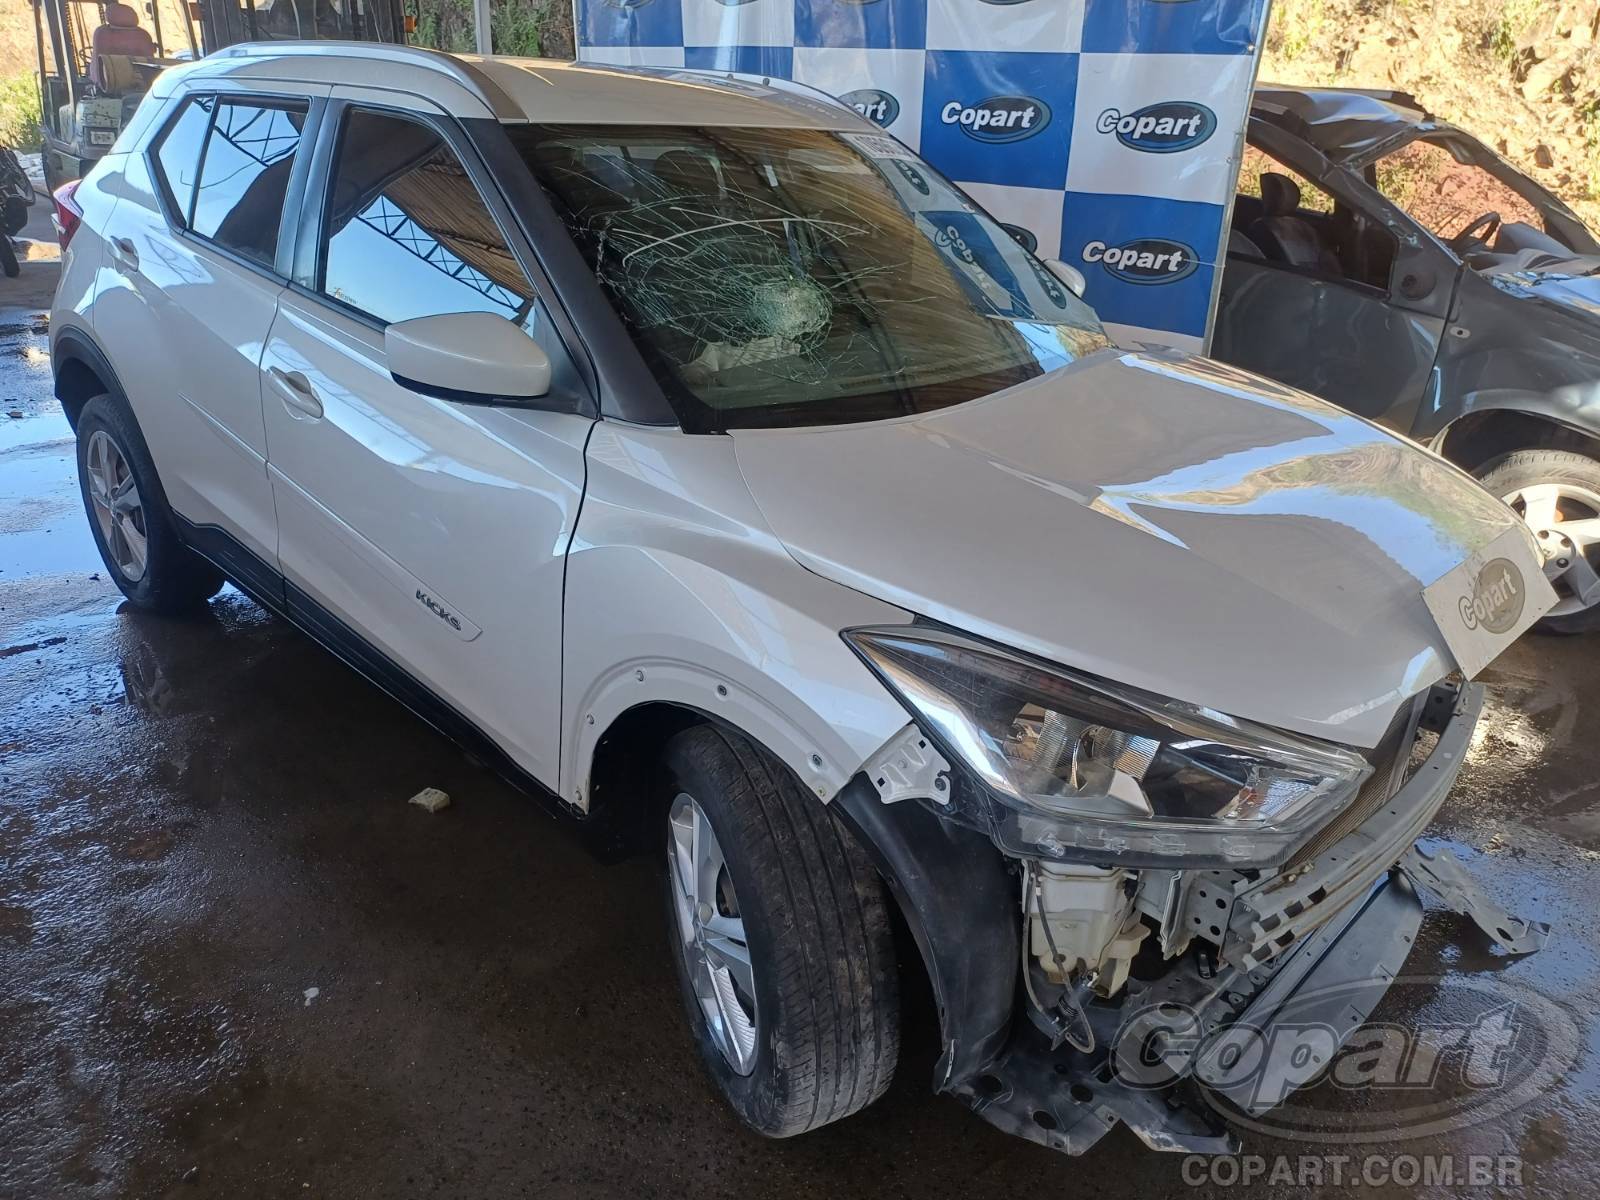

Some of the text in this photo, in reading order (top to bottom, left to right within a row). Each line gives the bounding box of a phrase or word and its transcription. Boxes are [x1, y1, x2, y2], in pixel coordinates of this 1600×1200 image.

[847, 101, 887, 120] art
[941, 102, 1036, 131] Copart
[1097, 108, 1202, 139] Copart
[1082, 241, 1185, 272] Copart
[415, 588, 462, 632] KICKS
[1459, 568, 1518, 630] Copart
